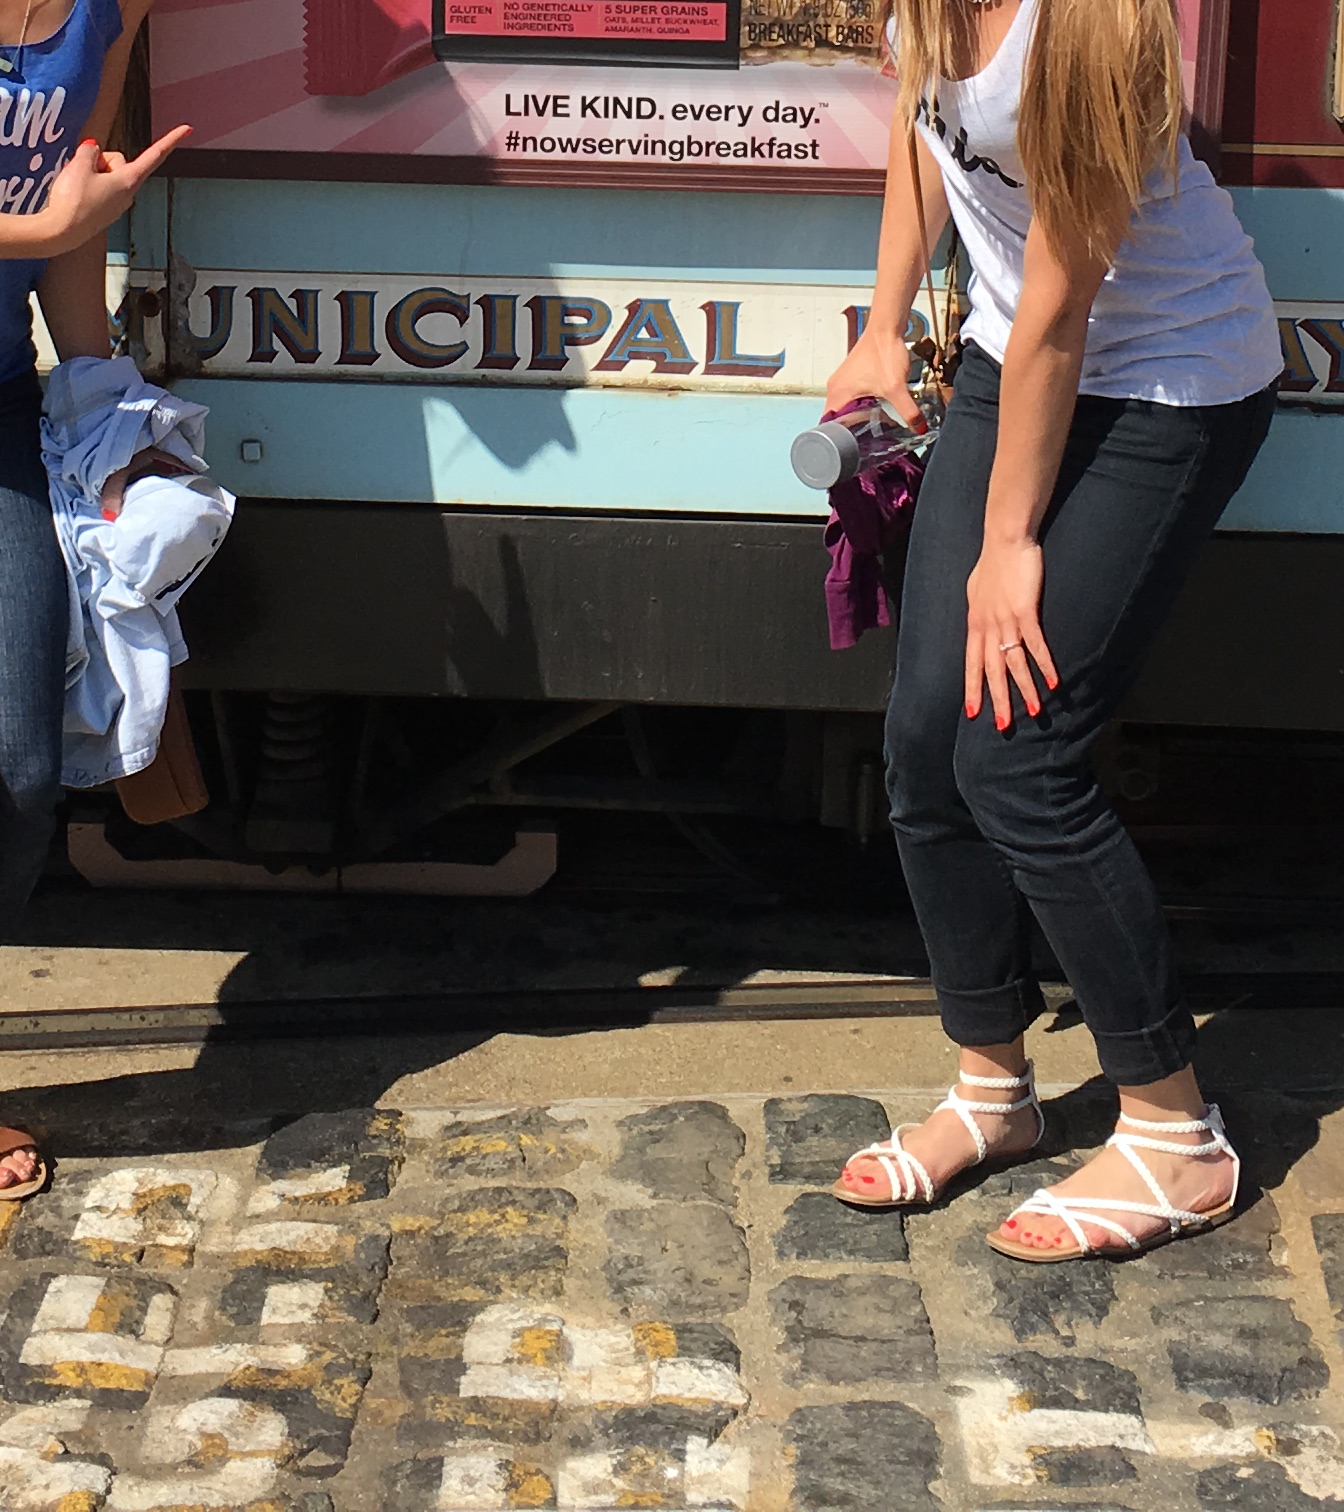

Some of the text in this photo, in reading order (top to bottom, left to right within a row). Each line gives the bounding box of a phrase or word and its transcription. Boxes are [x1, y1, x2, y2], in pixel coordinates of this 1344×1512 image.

[450, 5, 493, 15] GLUTEN
[503, 2, 594, 13] NO GENETICALLY
[604, 5, 709, 17] 5 SUPER GRAINS
[450, 15, 477, 24] FREE
[503, 12, 572, 23] ENGINEERED
[503, 22, 575, 33] INGREDIENTS
[748, 22, 875, 45] BREAKFAST BARS
[505, 93, 570, 117] LIVE
[581, 96, 665, 121] KIND.
[671, 102, 753, 127] every
[505, 131, 820, 162] #nowservingbreakfast
